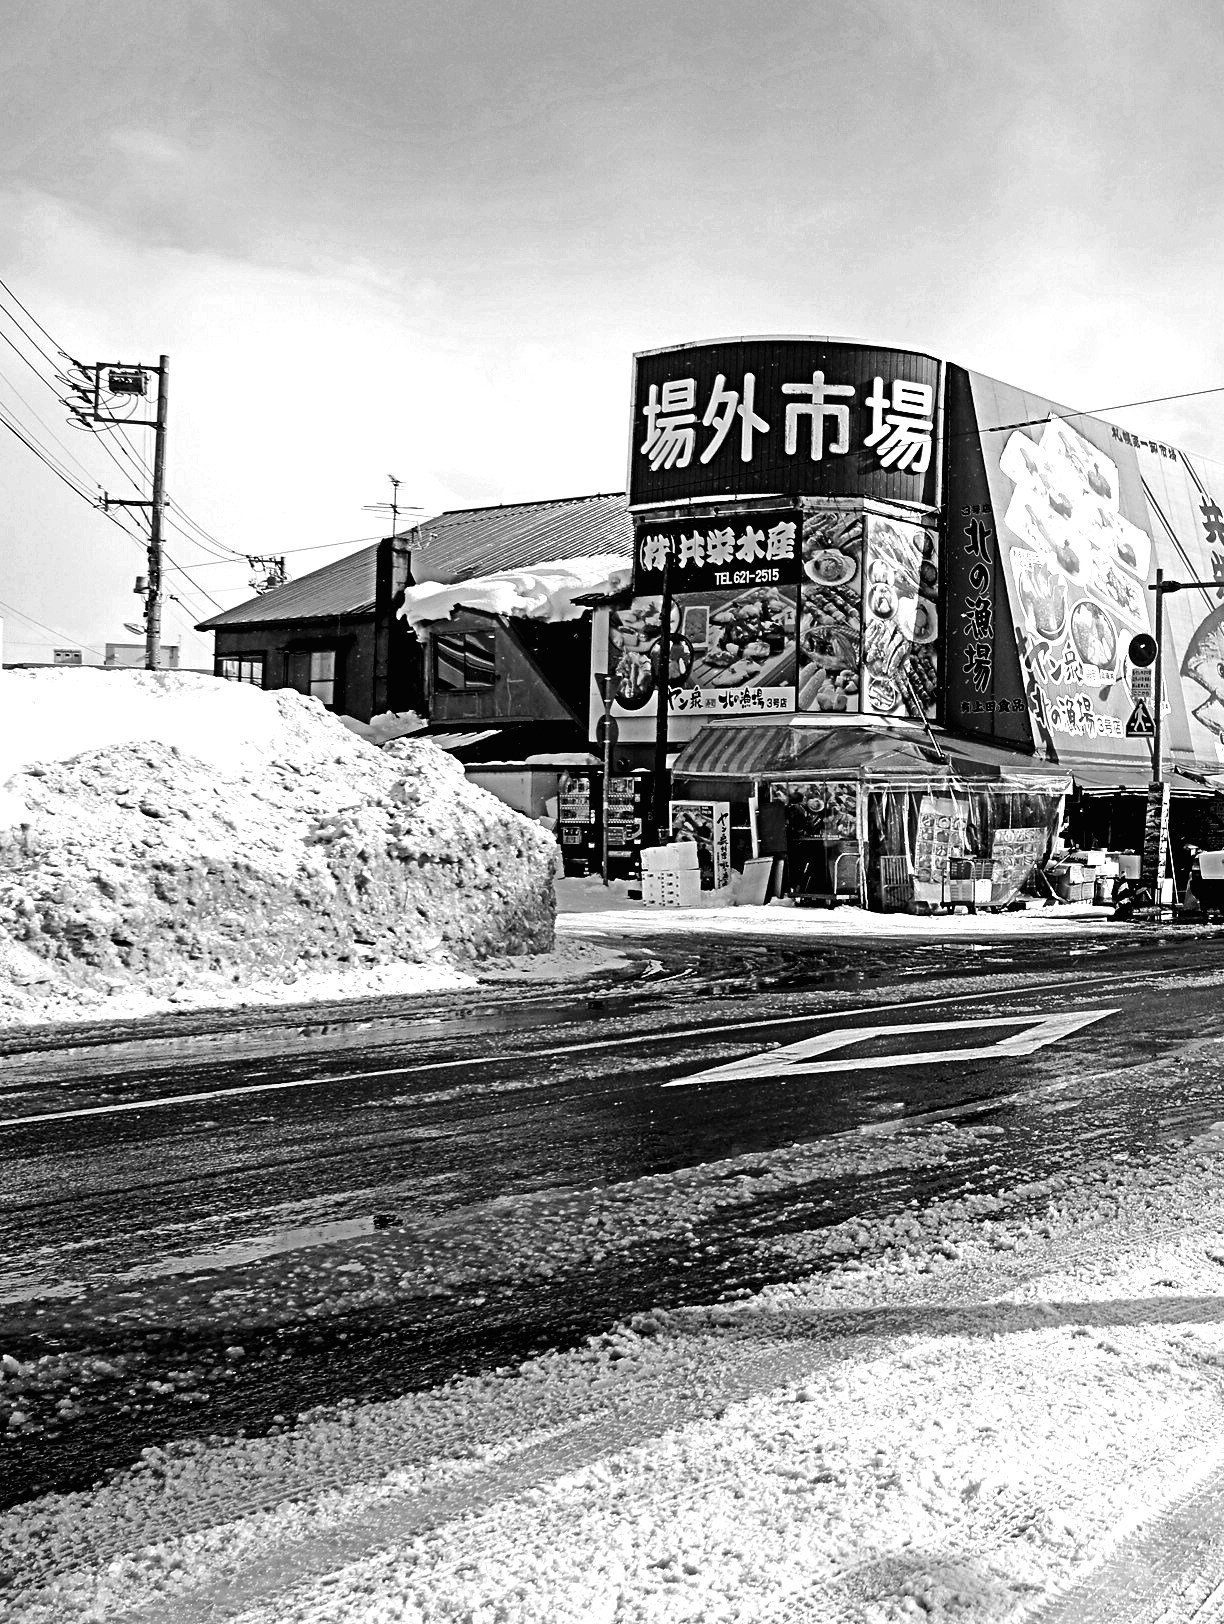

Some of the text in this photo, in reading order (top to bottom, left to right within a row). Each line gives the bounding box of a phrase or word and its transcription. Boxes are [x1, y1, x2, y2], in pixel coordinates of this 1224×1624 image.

[641, 370, 934, 473] 場外市場
[715, 569, 780, 586] TEL 621-2515
[963, 517, 993, 694] 北の漁場
[766, 697, 788, 709] 3号店
